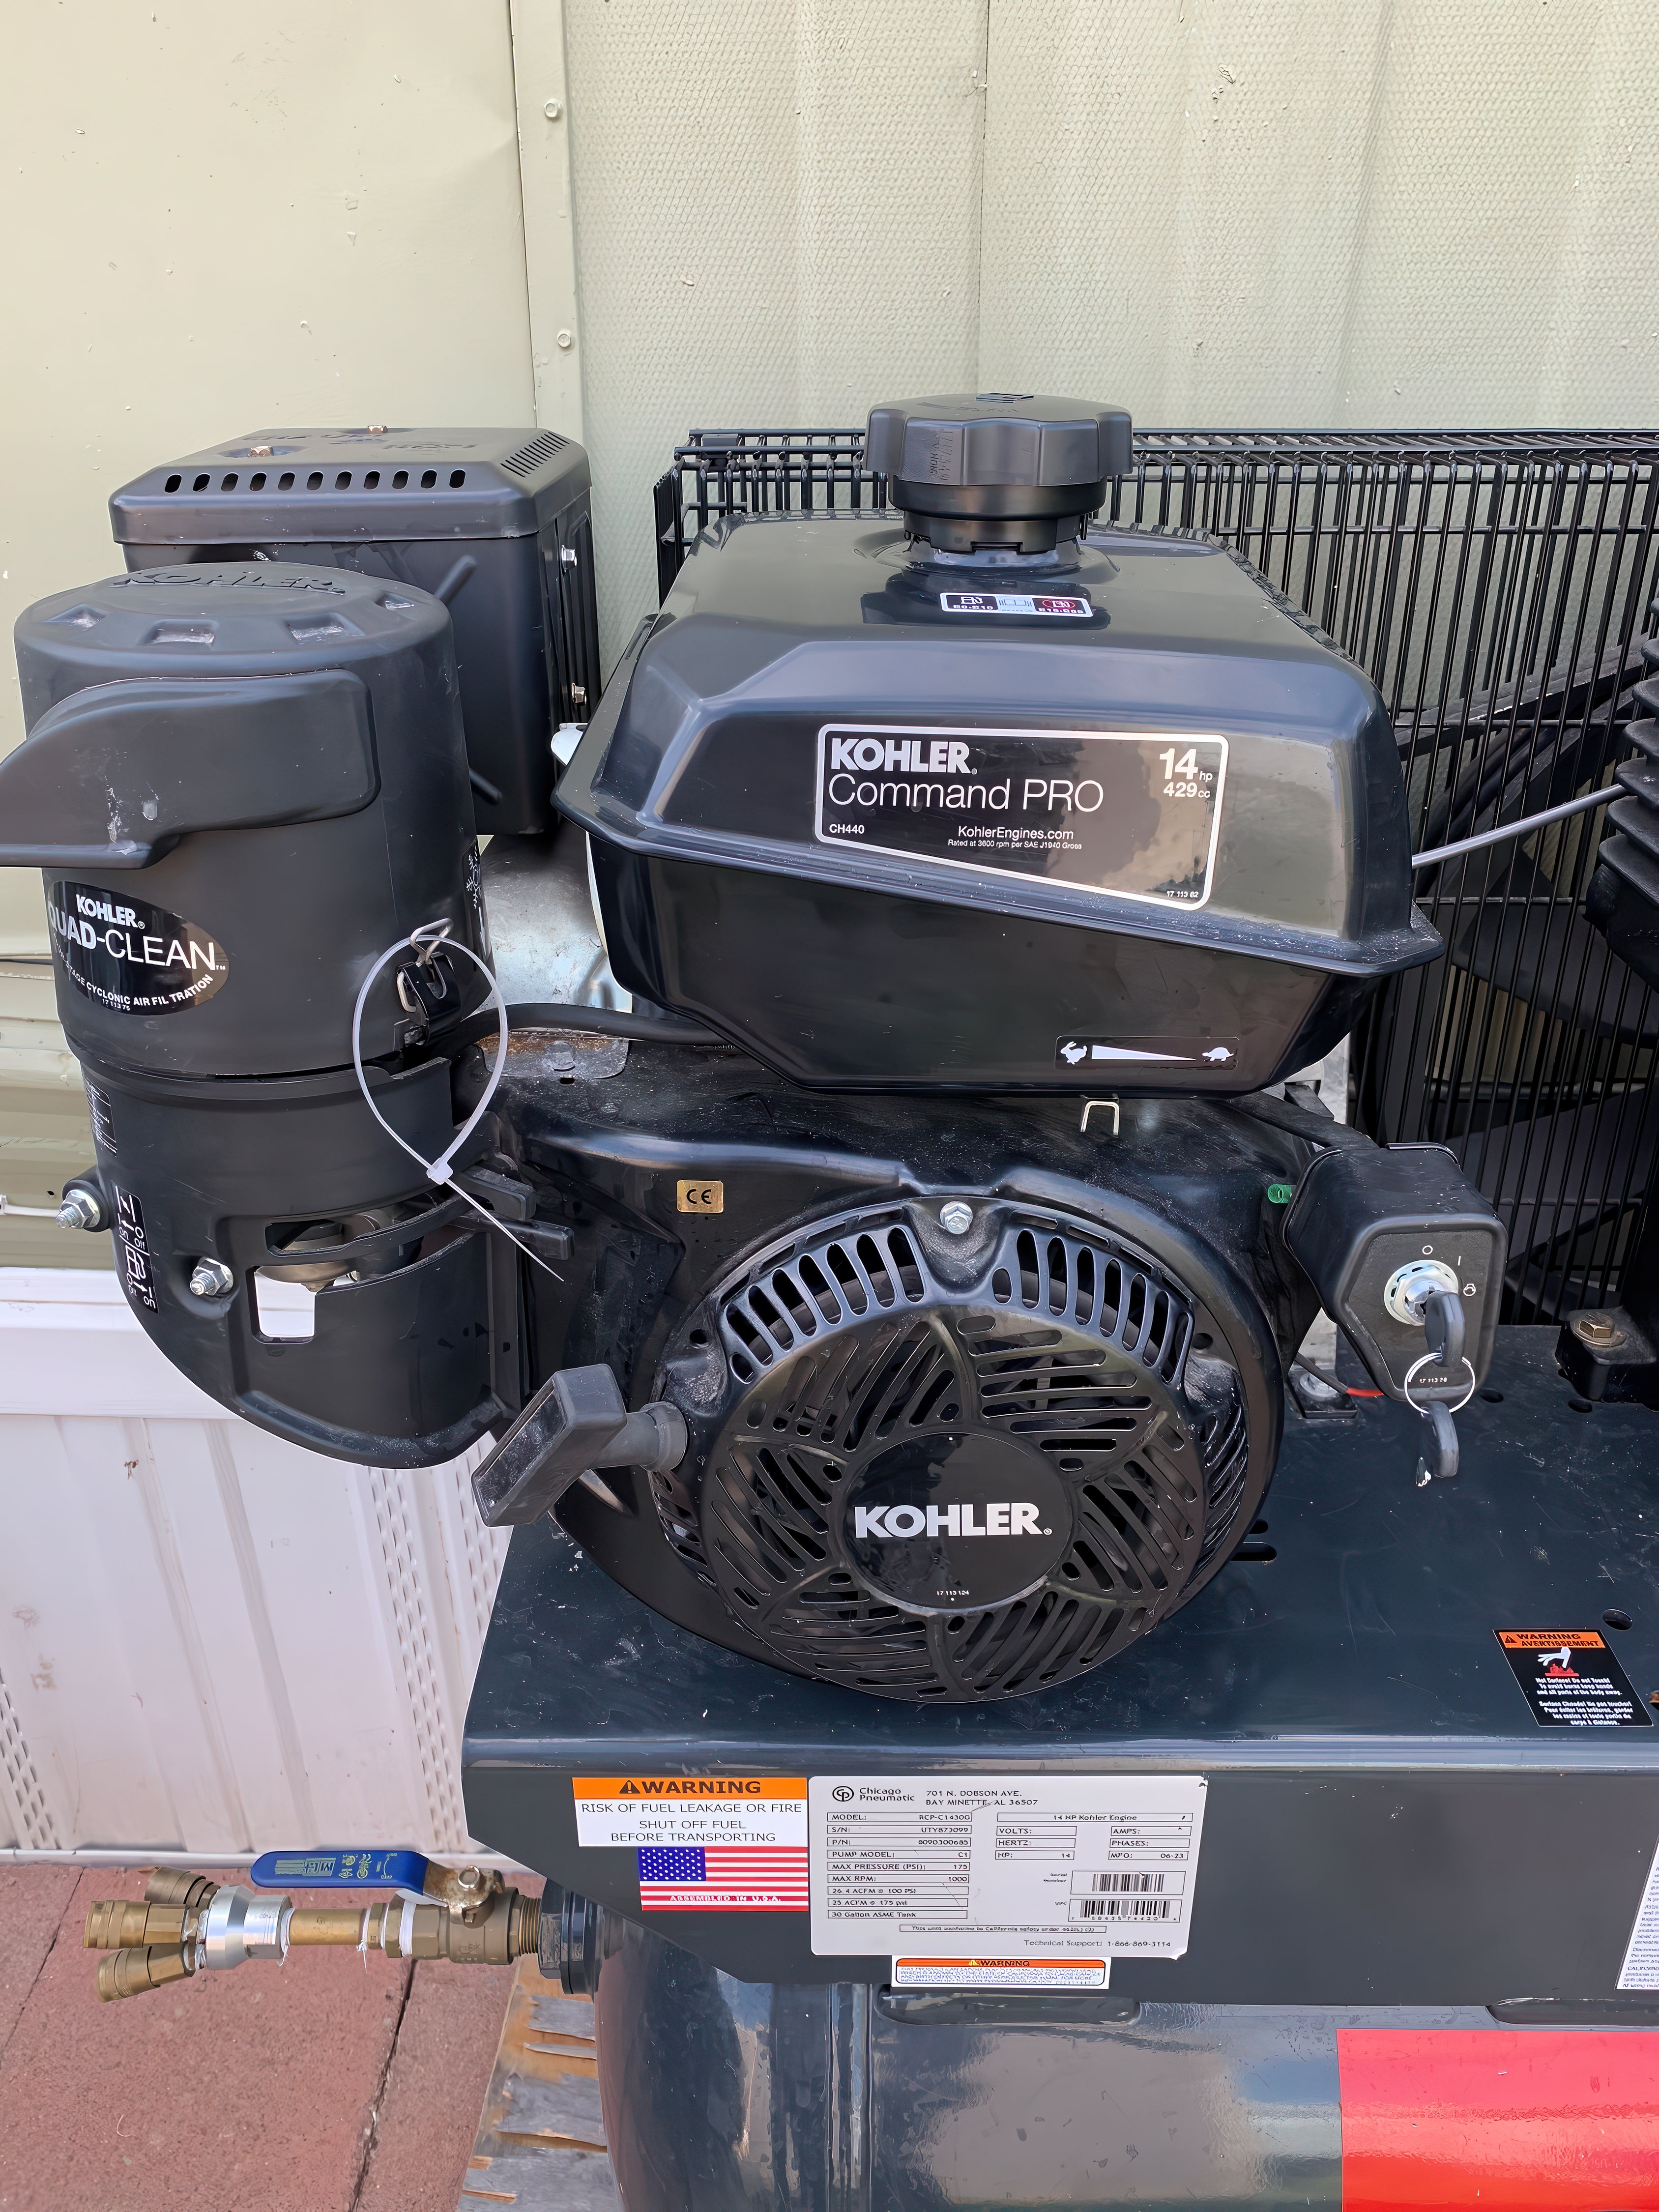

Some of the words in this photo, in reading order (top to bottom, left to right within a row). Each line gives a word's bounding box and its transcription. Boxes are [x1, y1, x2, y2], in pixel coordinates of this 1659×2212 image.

[829, 773, 1010, 810] Command
[1023, 779, 1104, 812] PRO
[829, 824, 865, 834] CH440
[959, 826, 1074, 842] KohlerEngines.com
[87, 981, 131, 1005] CYCLONIC
[134, 995, 150, 1006] AIR
[641, 1781, 761, 1793] WARNING
[859, 1787, 901, 1796] Chicago
[582, 1804, 613, 1812] RISK
[618, 1804, 636, 1812] OF
[641, 1804, 675, 1812] FUEL
[680, 1804, 741, 1812] LEAKAGE
[746, 1804, 766, 1812] OR
[771, 1804, 802, 1812] FIRE
[640, 1820, 676, 1829] SHUT
[681, 1820, 707, 1829] OFF
[713, 1820, 746, 1829] FUEL
[611, 1833, 664, 1841] BEFORE
[669, 1833, 776, 1841] TRANSPORTING
